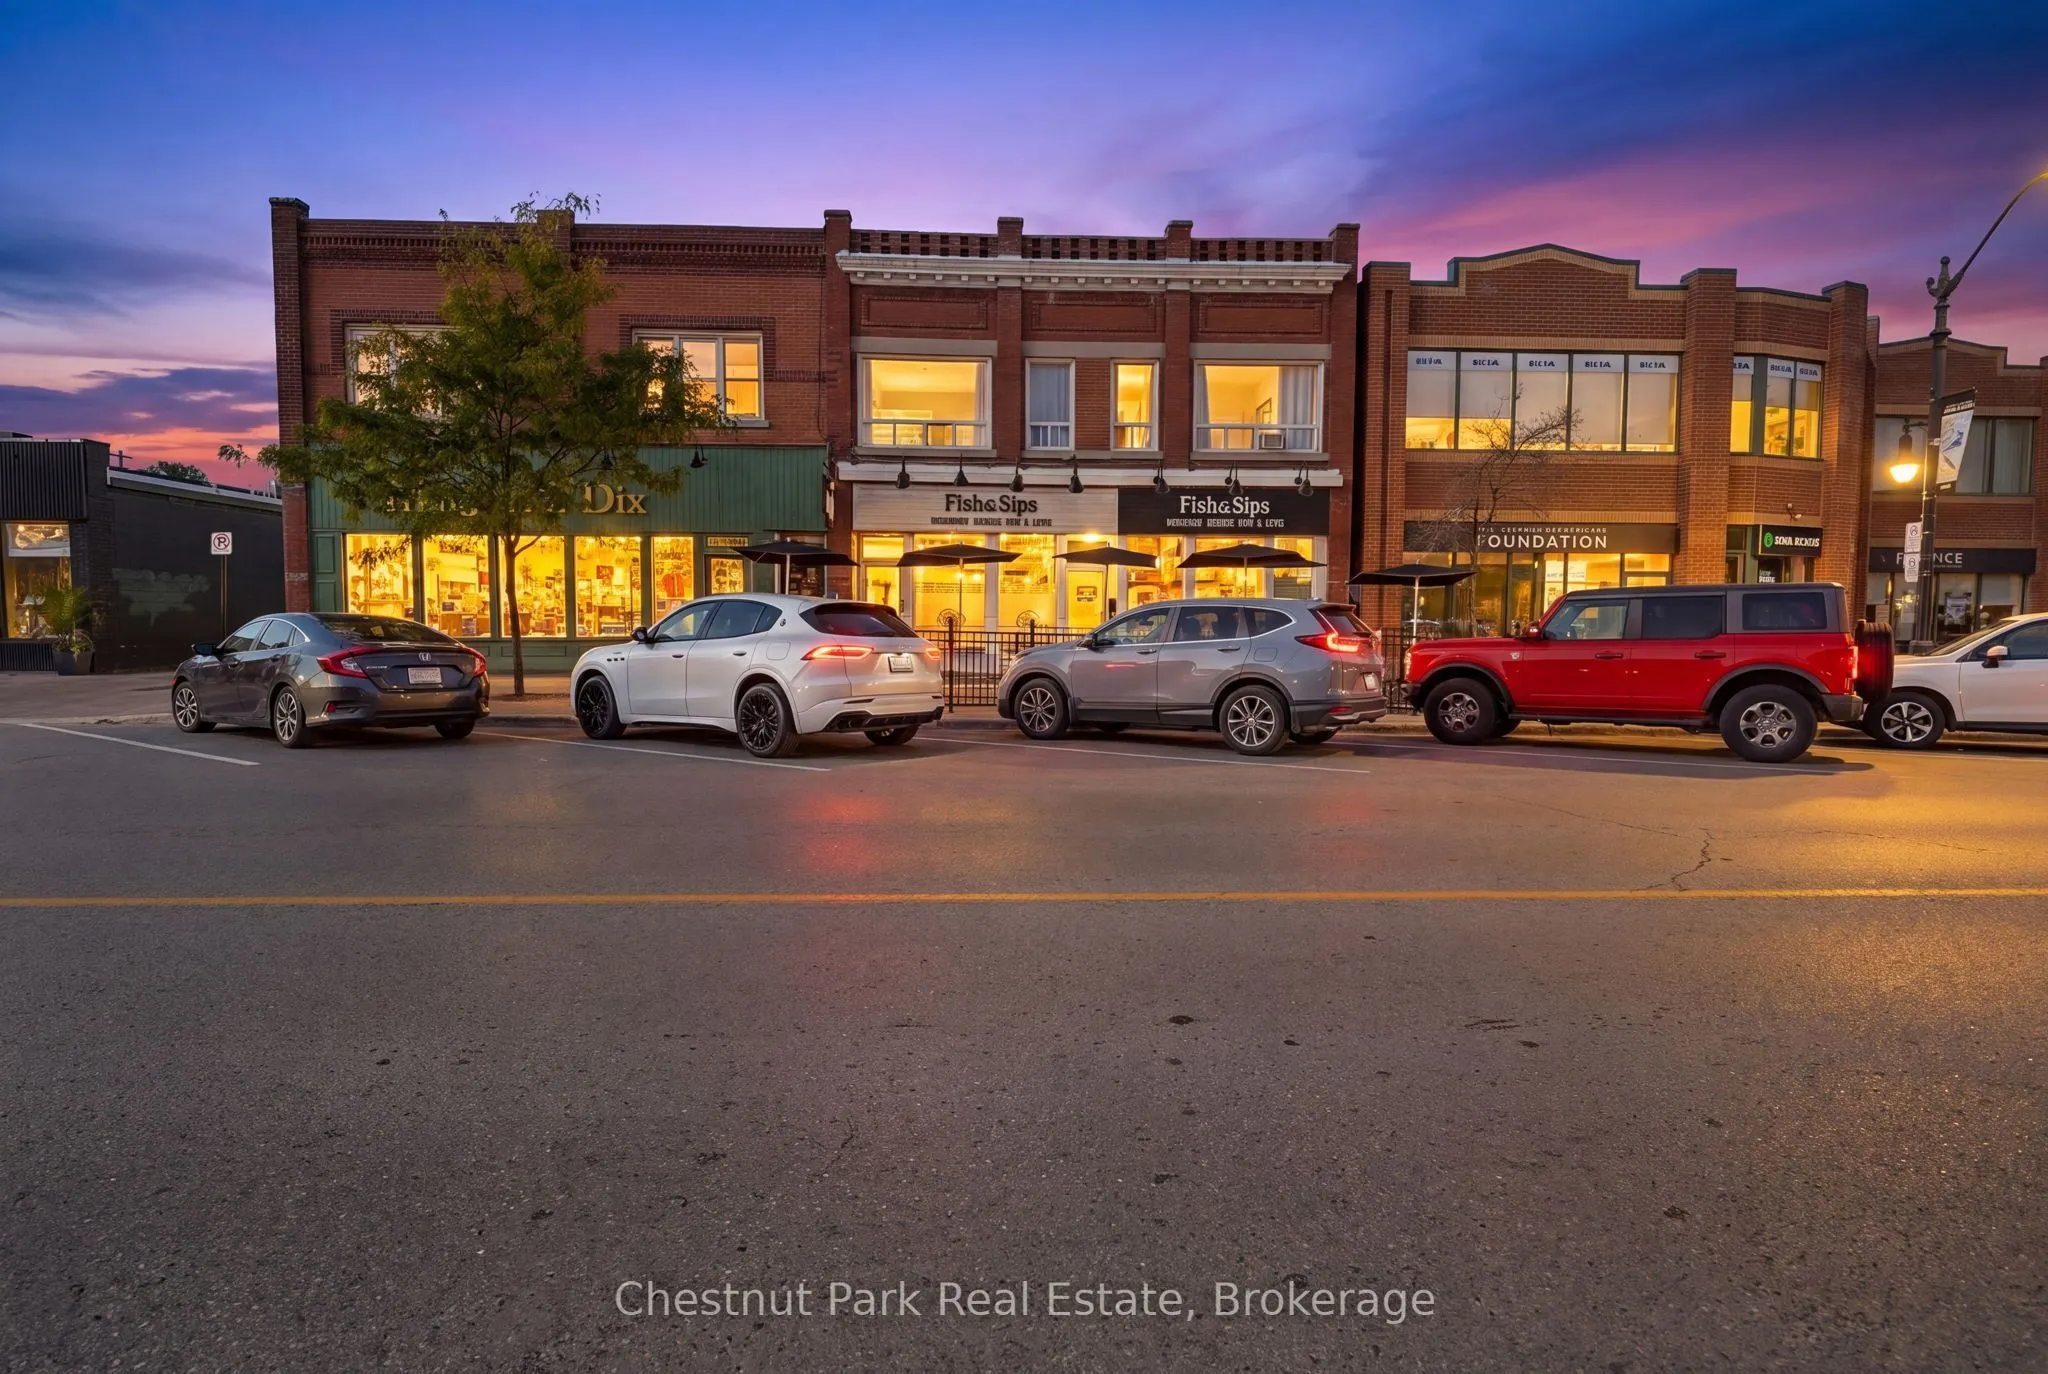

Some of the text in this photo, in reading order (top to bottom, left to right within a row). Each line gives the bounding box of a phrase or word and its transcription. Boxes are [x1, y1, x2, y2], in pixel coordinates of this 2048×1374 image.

[582, 484, 648, 514] Dix
[1477, 534, 1607, 548] FOUNDATION
[1896, 552, 1963, 565] FNCE
